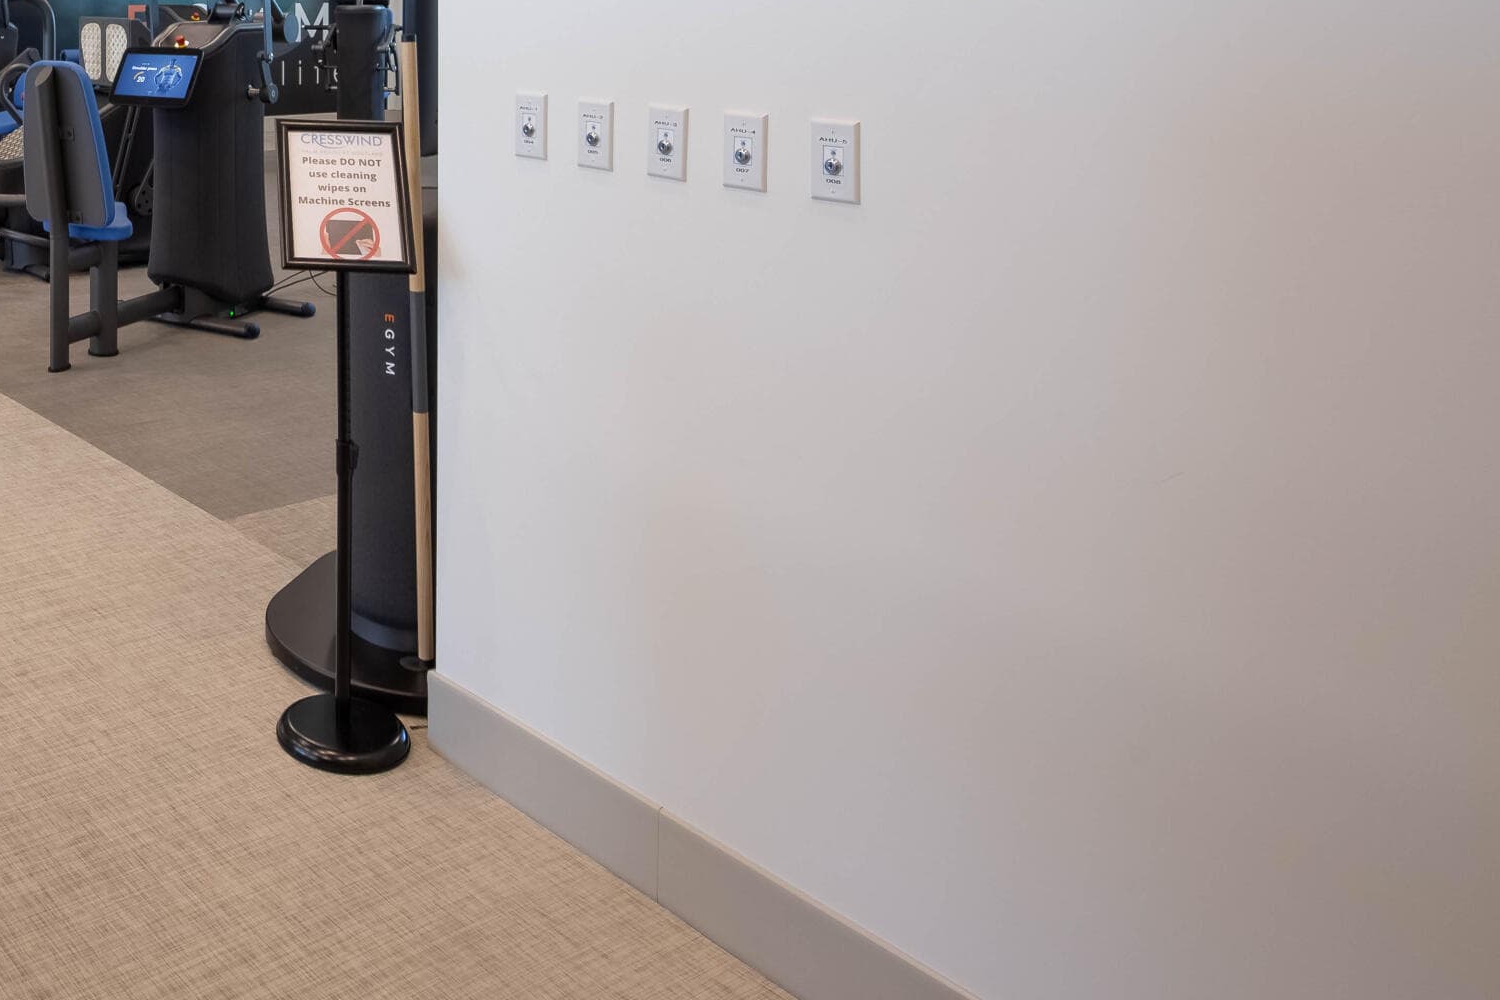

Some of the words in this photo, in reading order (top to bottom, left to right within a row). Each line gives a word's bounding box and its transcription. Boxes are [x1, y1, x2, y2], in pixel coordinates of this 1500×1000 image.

[300, 133, 383, 149] CRESSWIND
[302, 156, 337, 166] Please
[339, 157, 356, 166] DO
[358, 158, 382, 167] NOT
[308, 170, 328, 178] use
[331, 170, 377, 182] cleaning
[318, 184, 350, 193] wipes
[298, 196, 346, 206] Machine
[347, 197, 391, 208] Screens
[384, 313, 396, 376] EGYM
